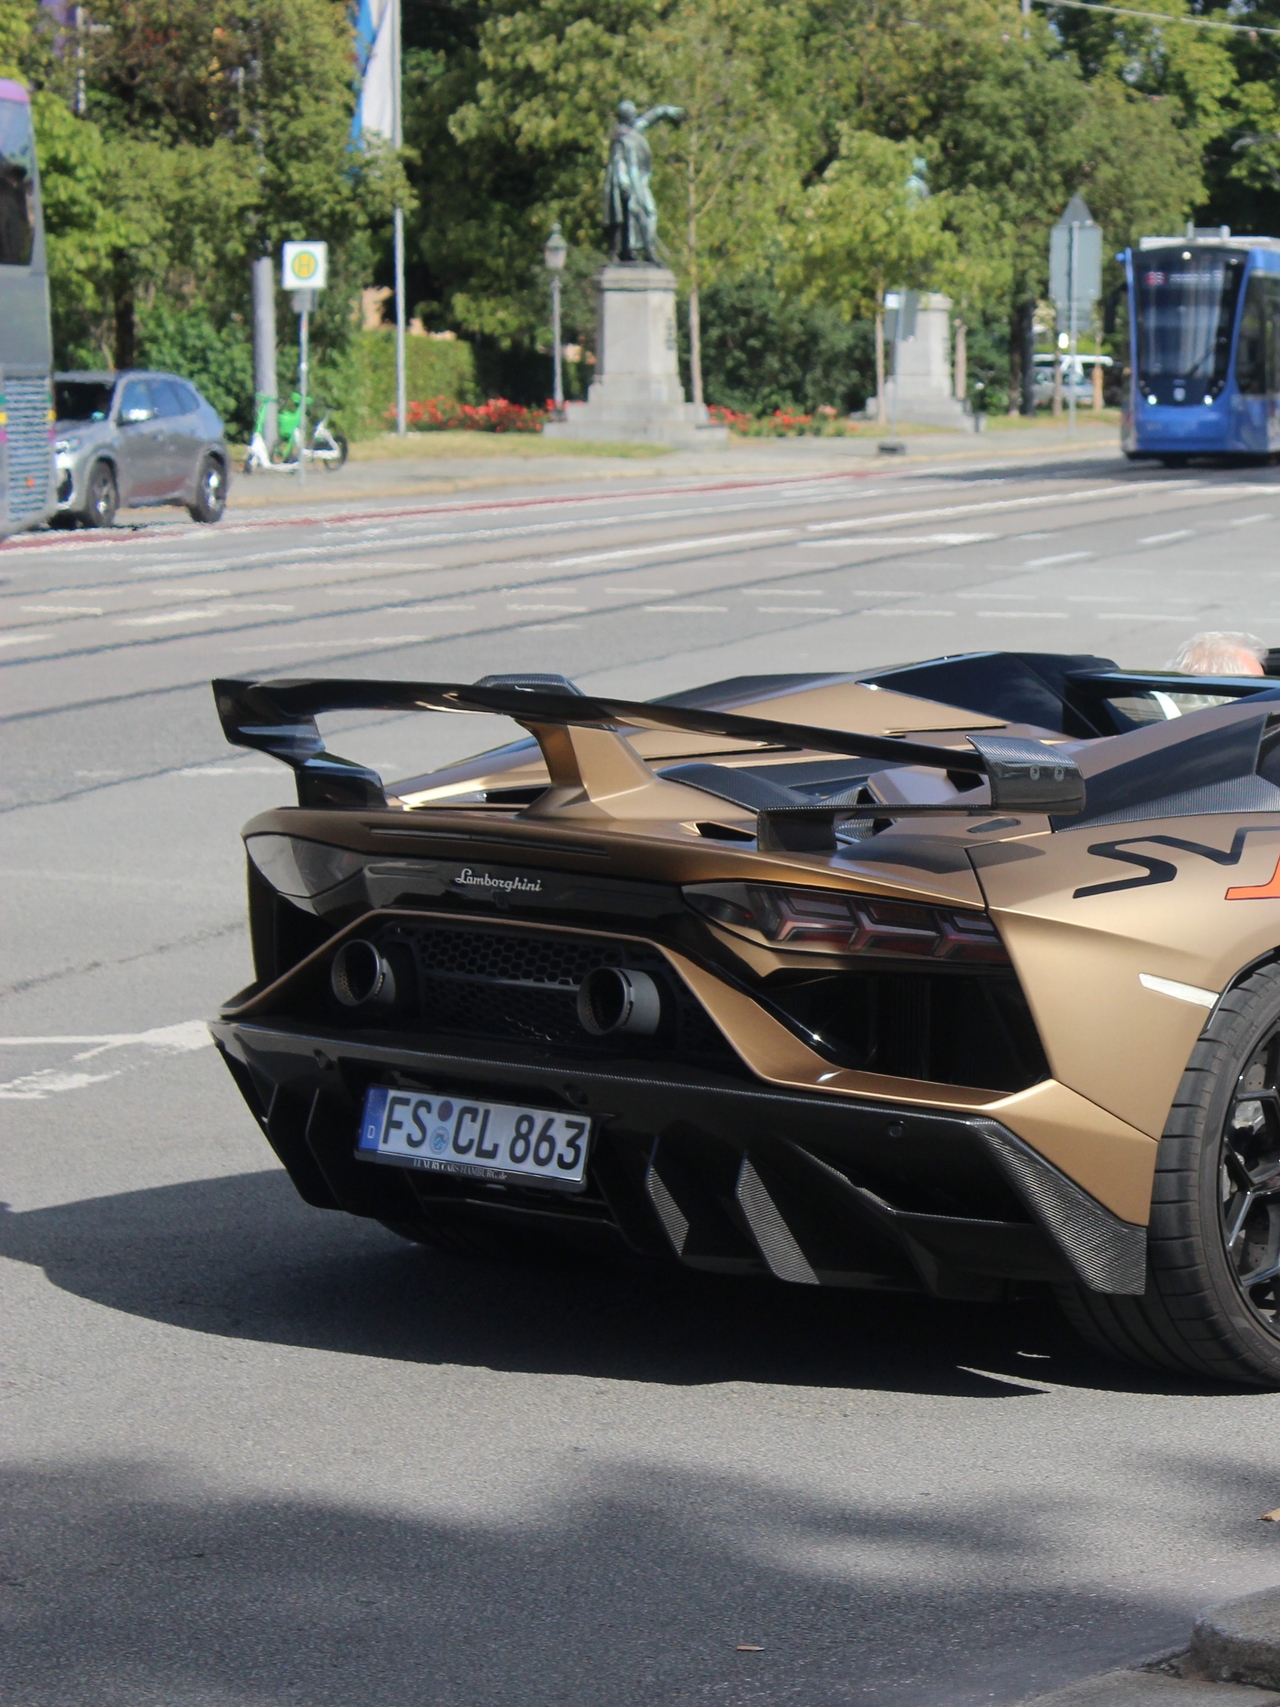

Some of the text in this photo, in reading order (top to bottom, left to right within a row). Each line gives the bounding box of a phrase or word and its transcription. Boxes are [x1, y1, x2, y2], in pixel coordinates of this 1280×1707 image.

[455, 868, 542, 892] Lamborghini
[367, 1125, 376, 1139] D
[382, 1096, 586, 1171] FS CL 863
